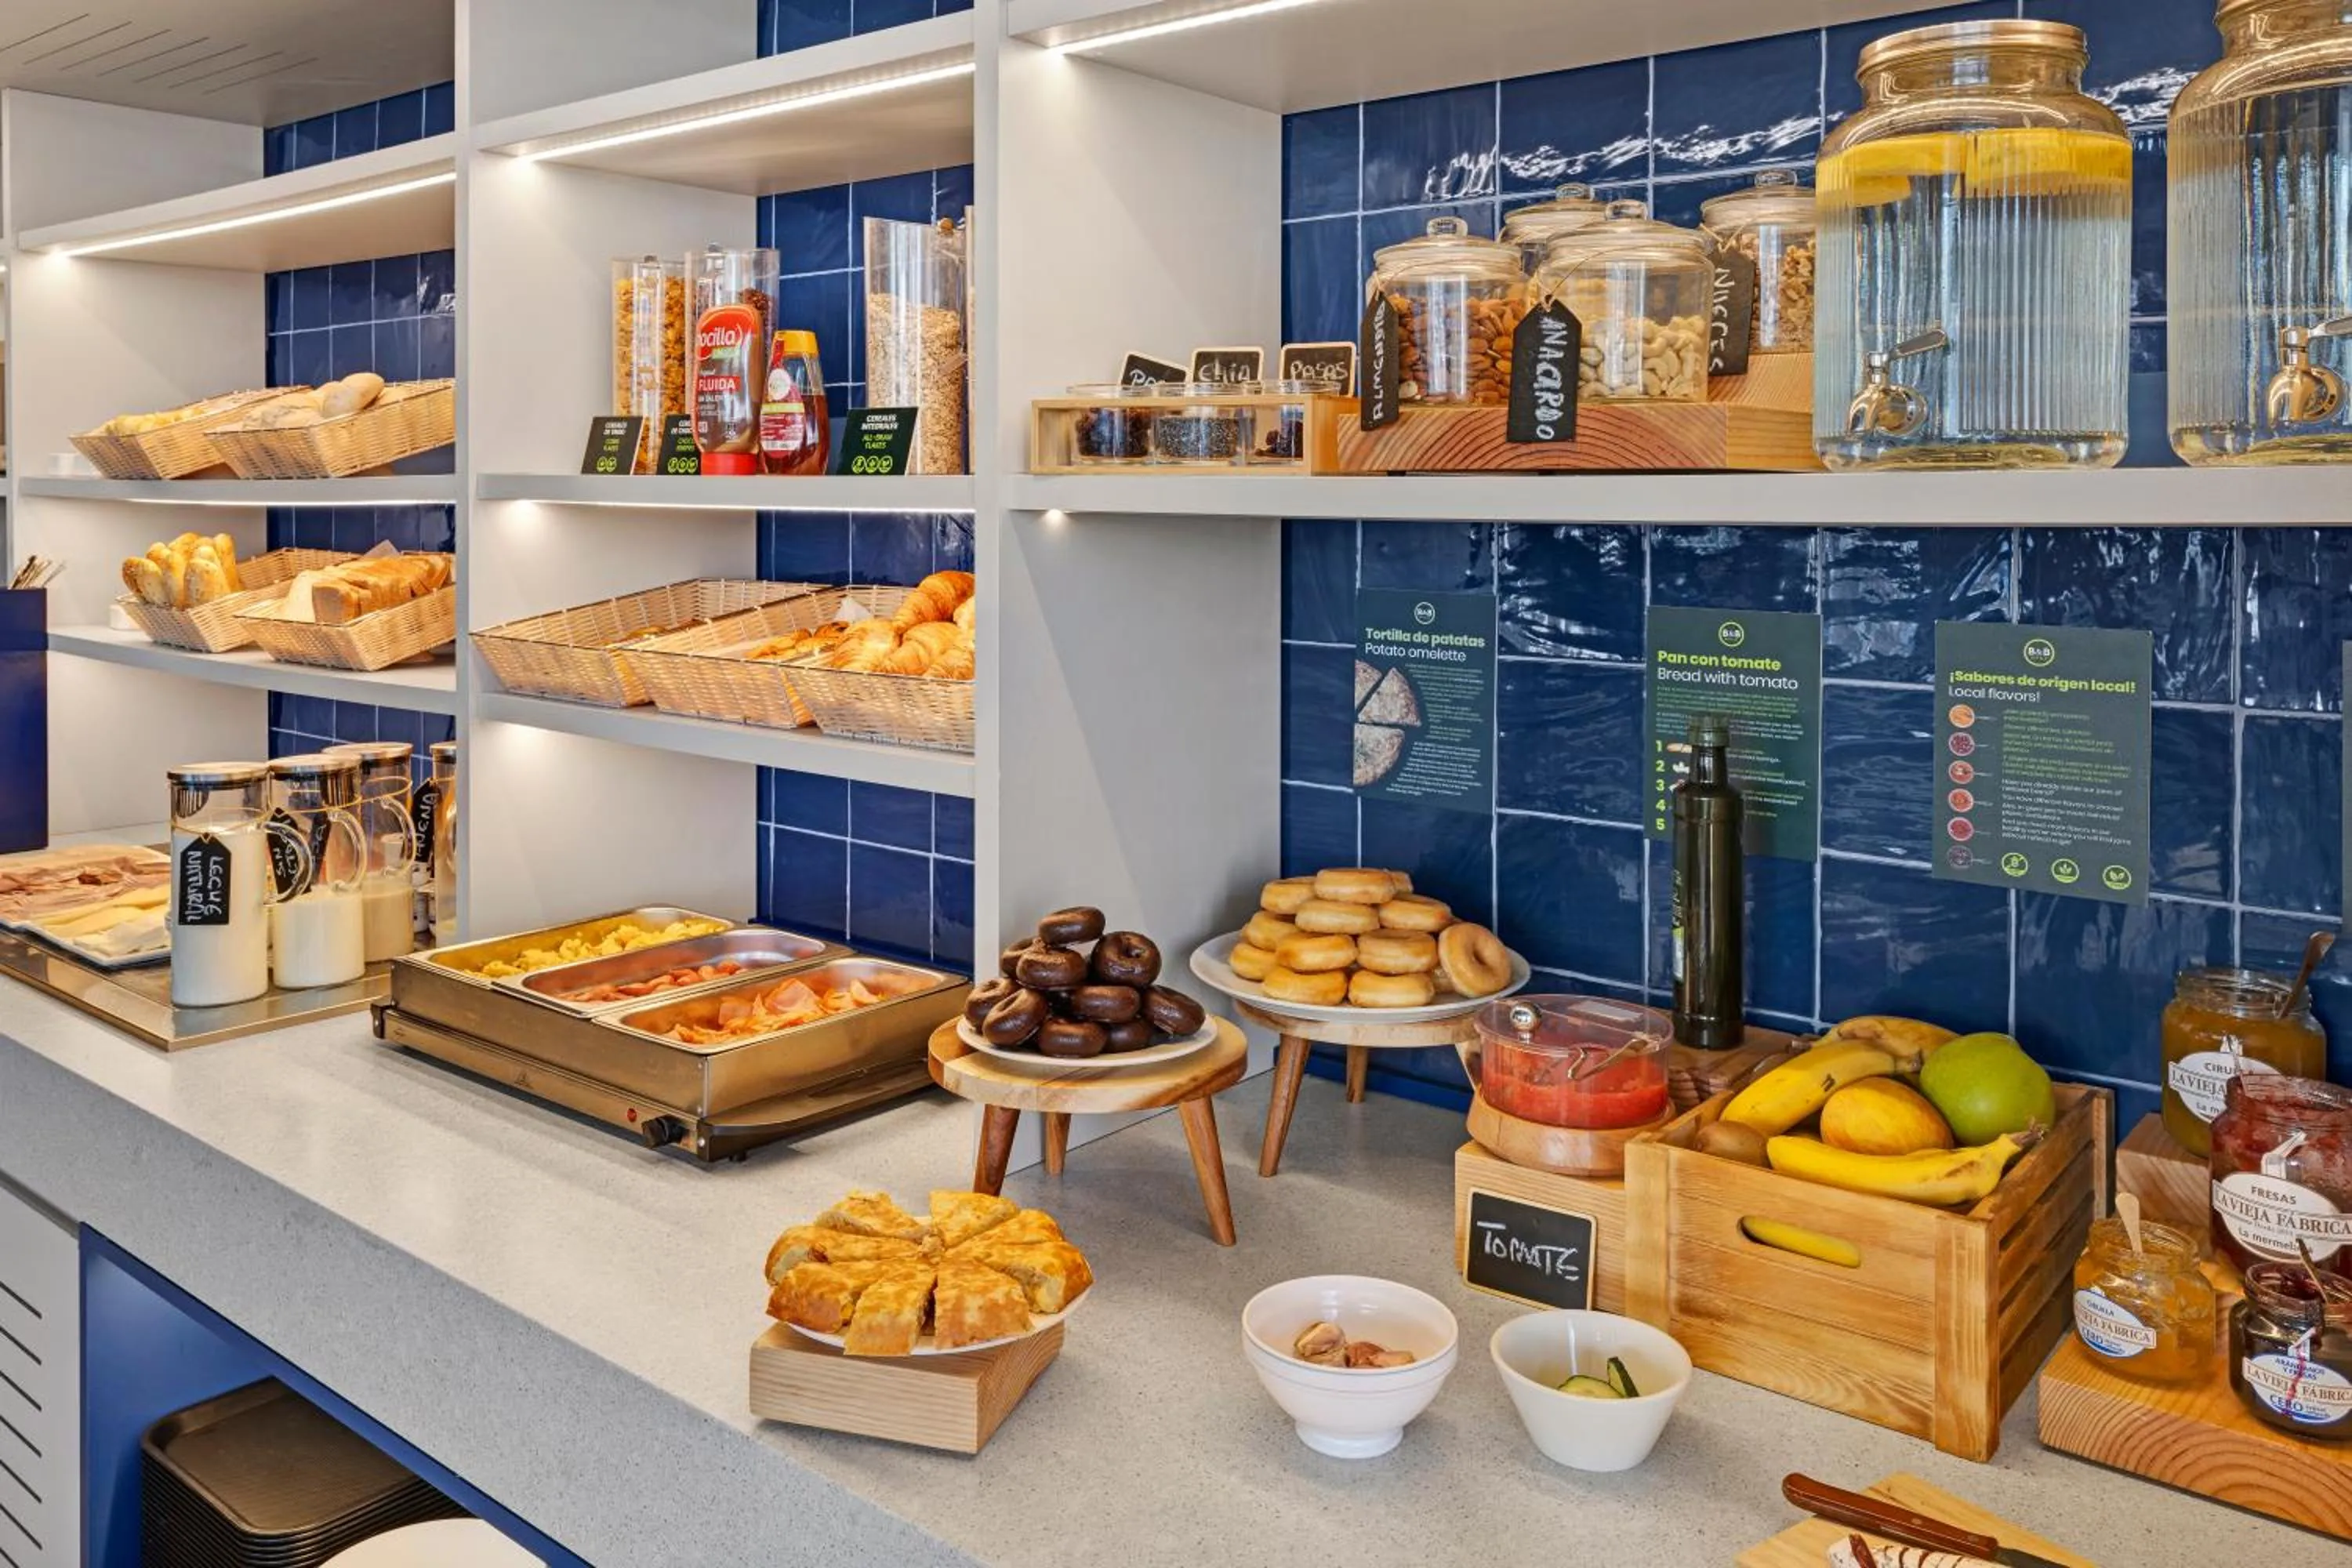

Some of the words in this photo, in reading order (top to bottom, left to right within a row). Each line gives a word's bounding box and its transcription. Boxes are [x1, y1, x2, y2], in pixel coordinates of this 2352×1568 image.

[1290, 360, 1348, 381] PASAS
[1533, 316, 1569, 440] ANACARDO
[698, 378, 736, 391] FLUIDA
[1365, 628, 1410, 642] Tortilla
[1413, 631, 1429, 643] de
[1431, 634, 1485, 648] patatas
[1365, 643, 1406, 656] Potato
[1408, 648, 1467, 662] omelette
[1657, 650, 1687, 664] Pan
[1690, 654, 1719, 666] con
[1721, 655, 1782, 671] tomate
[1657, 667, 1701, 683] Bread
[1704, 670, 1736, 685] with
[1740, 675, 1798, 690] tomato
[1949, 670, 2015, 685] ¡Sabores
[2016, 674, 2036, 687] de
[2038, 676, 2089, 692] origen
[2091, 679, 2136, 694] local!
[1948, 685, 1986, 699] Local
[1987, 687, 2041, 702] flavors!
[1655, 739, 1663, 753] 1
[1655, 760, 1665, 772] 2
[1655, 779, 1665, 792] 3
[1655, 799, 1665, 811] 4
[1655, 818, 1665, 830] 5
[185, 851, 204, 922] NATURAL
[204, 855, 224, 916] LECHE
[2172, 1069, 2186, 1087] LA
[2187, 1075, 2226, 1095] VIEJA
[2251, 1185, 2296, 1205] FRESAS
[2215, 1187, 2227, 1207] LA
[2228, 1196, 2271, 1224] VIEJA
[2276, 1210, 2352, 1235] FÁBRICA
[2238, 1226, 2249, 1239] La
[2247, 1365, 2261, 1380] LA
[2263, 1374, 2294, 1393] VIEJ
